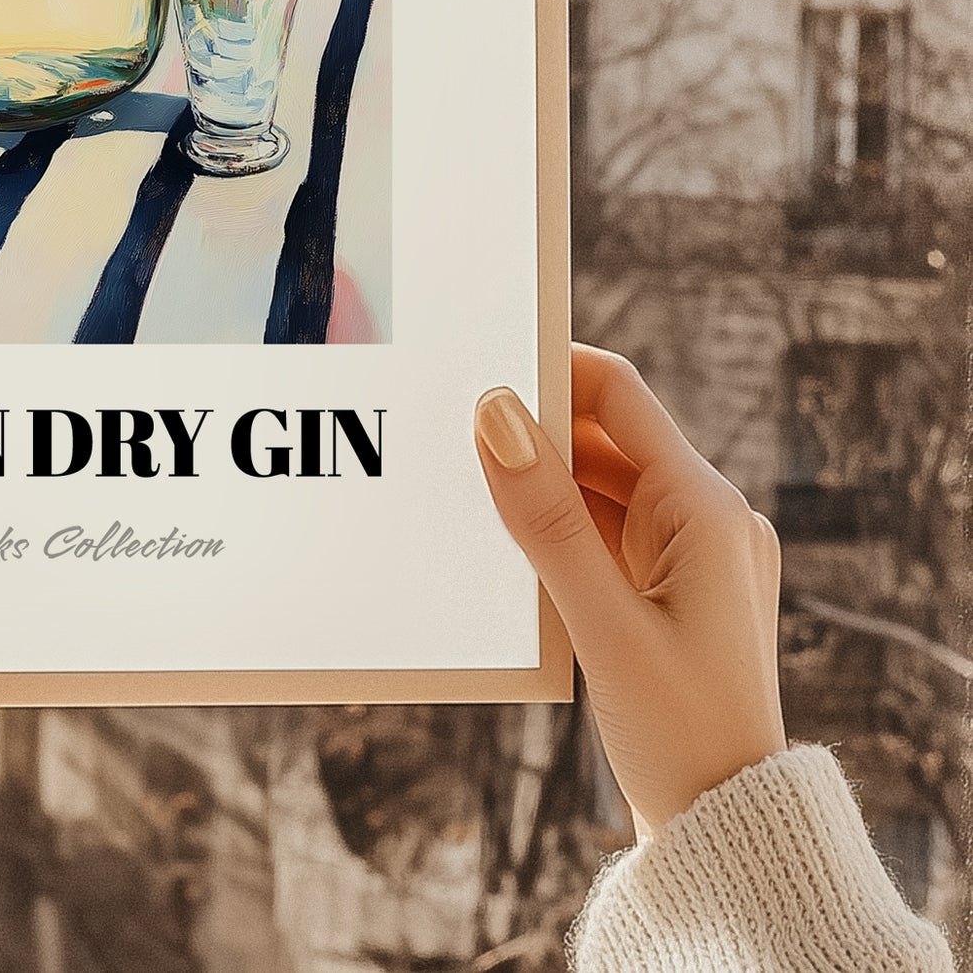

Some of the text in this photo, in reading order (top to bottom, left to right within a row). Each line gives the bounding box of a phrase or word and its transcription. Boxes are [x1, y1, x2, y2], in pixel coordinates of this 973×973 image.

[26, 409, 214, 478] DRY
[230, 408, 388, 478] GIN
[42, 520, 226, 561] Collection
